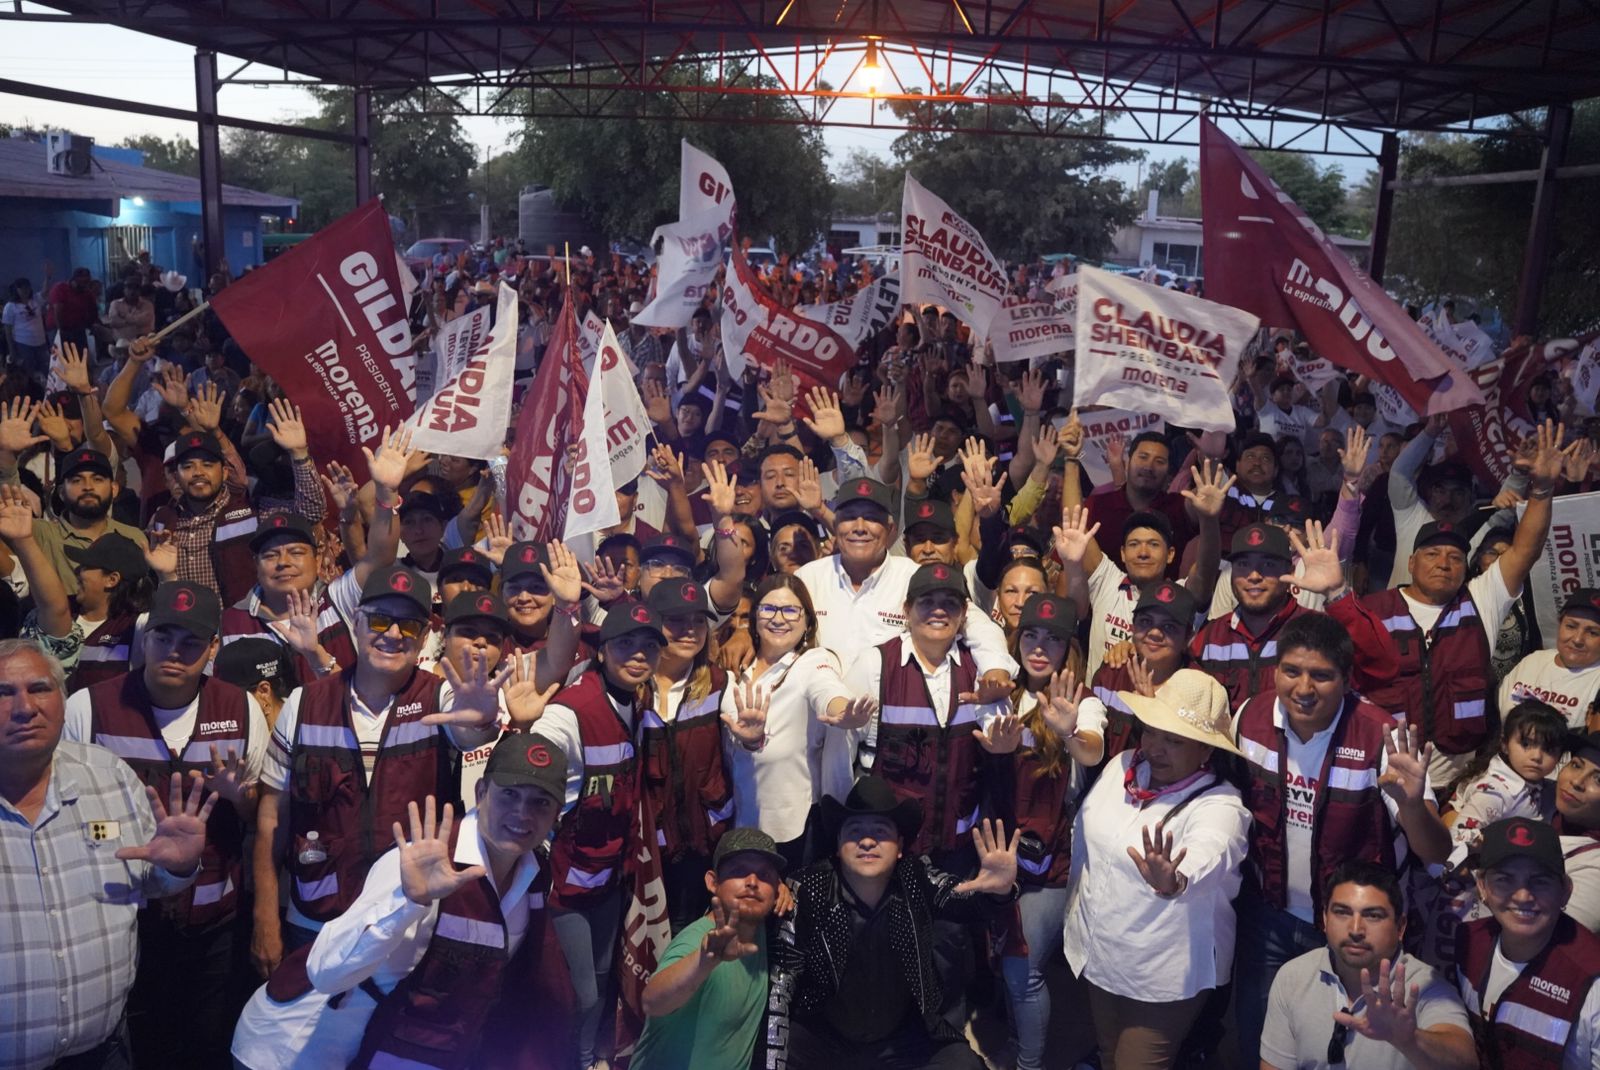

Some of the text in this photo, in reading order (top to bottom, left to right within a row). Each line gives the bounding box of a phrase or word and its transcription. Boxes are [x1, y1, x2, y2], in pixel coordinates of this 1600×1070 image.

[1283, 283, 1294, 295] La
[1009, 323, 1073, 343] morena
[1094, 298, 1226, 358] CLAUDIA
[304, 352, 314, 364] La
[338, 400, 347, 413] de
[356, 343, 400, 411] PRESIDENTE
[315, 338, 379, 443] morena
[224, 508, 253, 519] morena
[200, 720, 239, 732] morena
[1530, 976, 1571, 1000] morena
